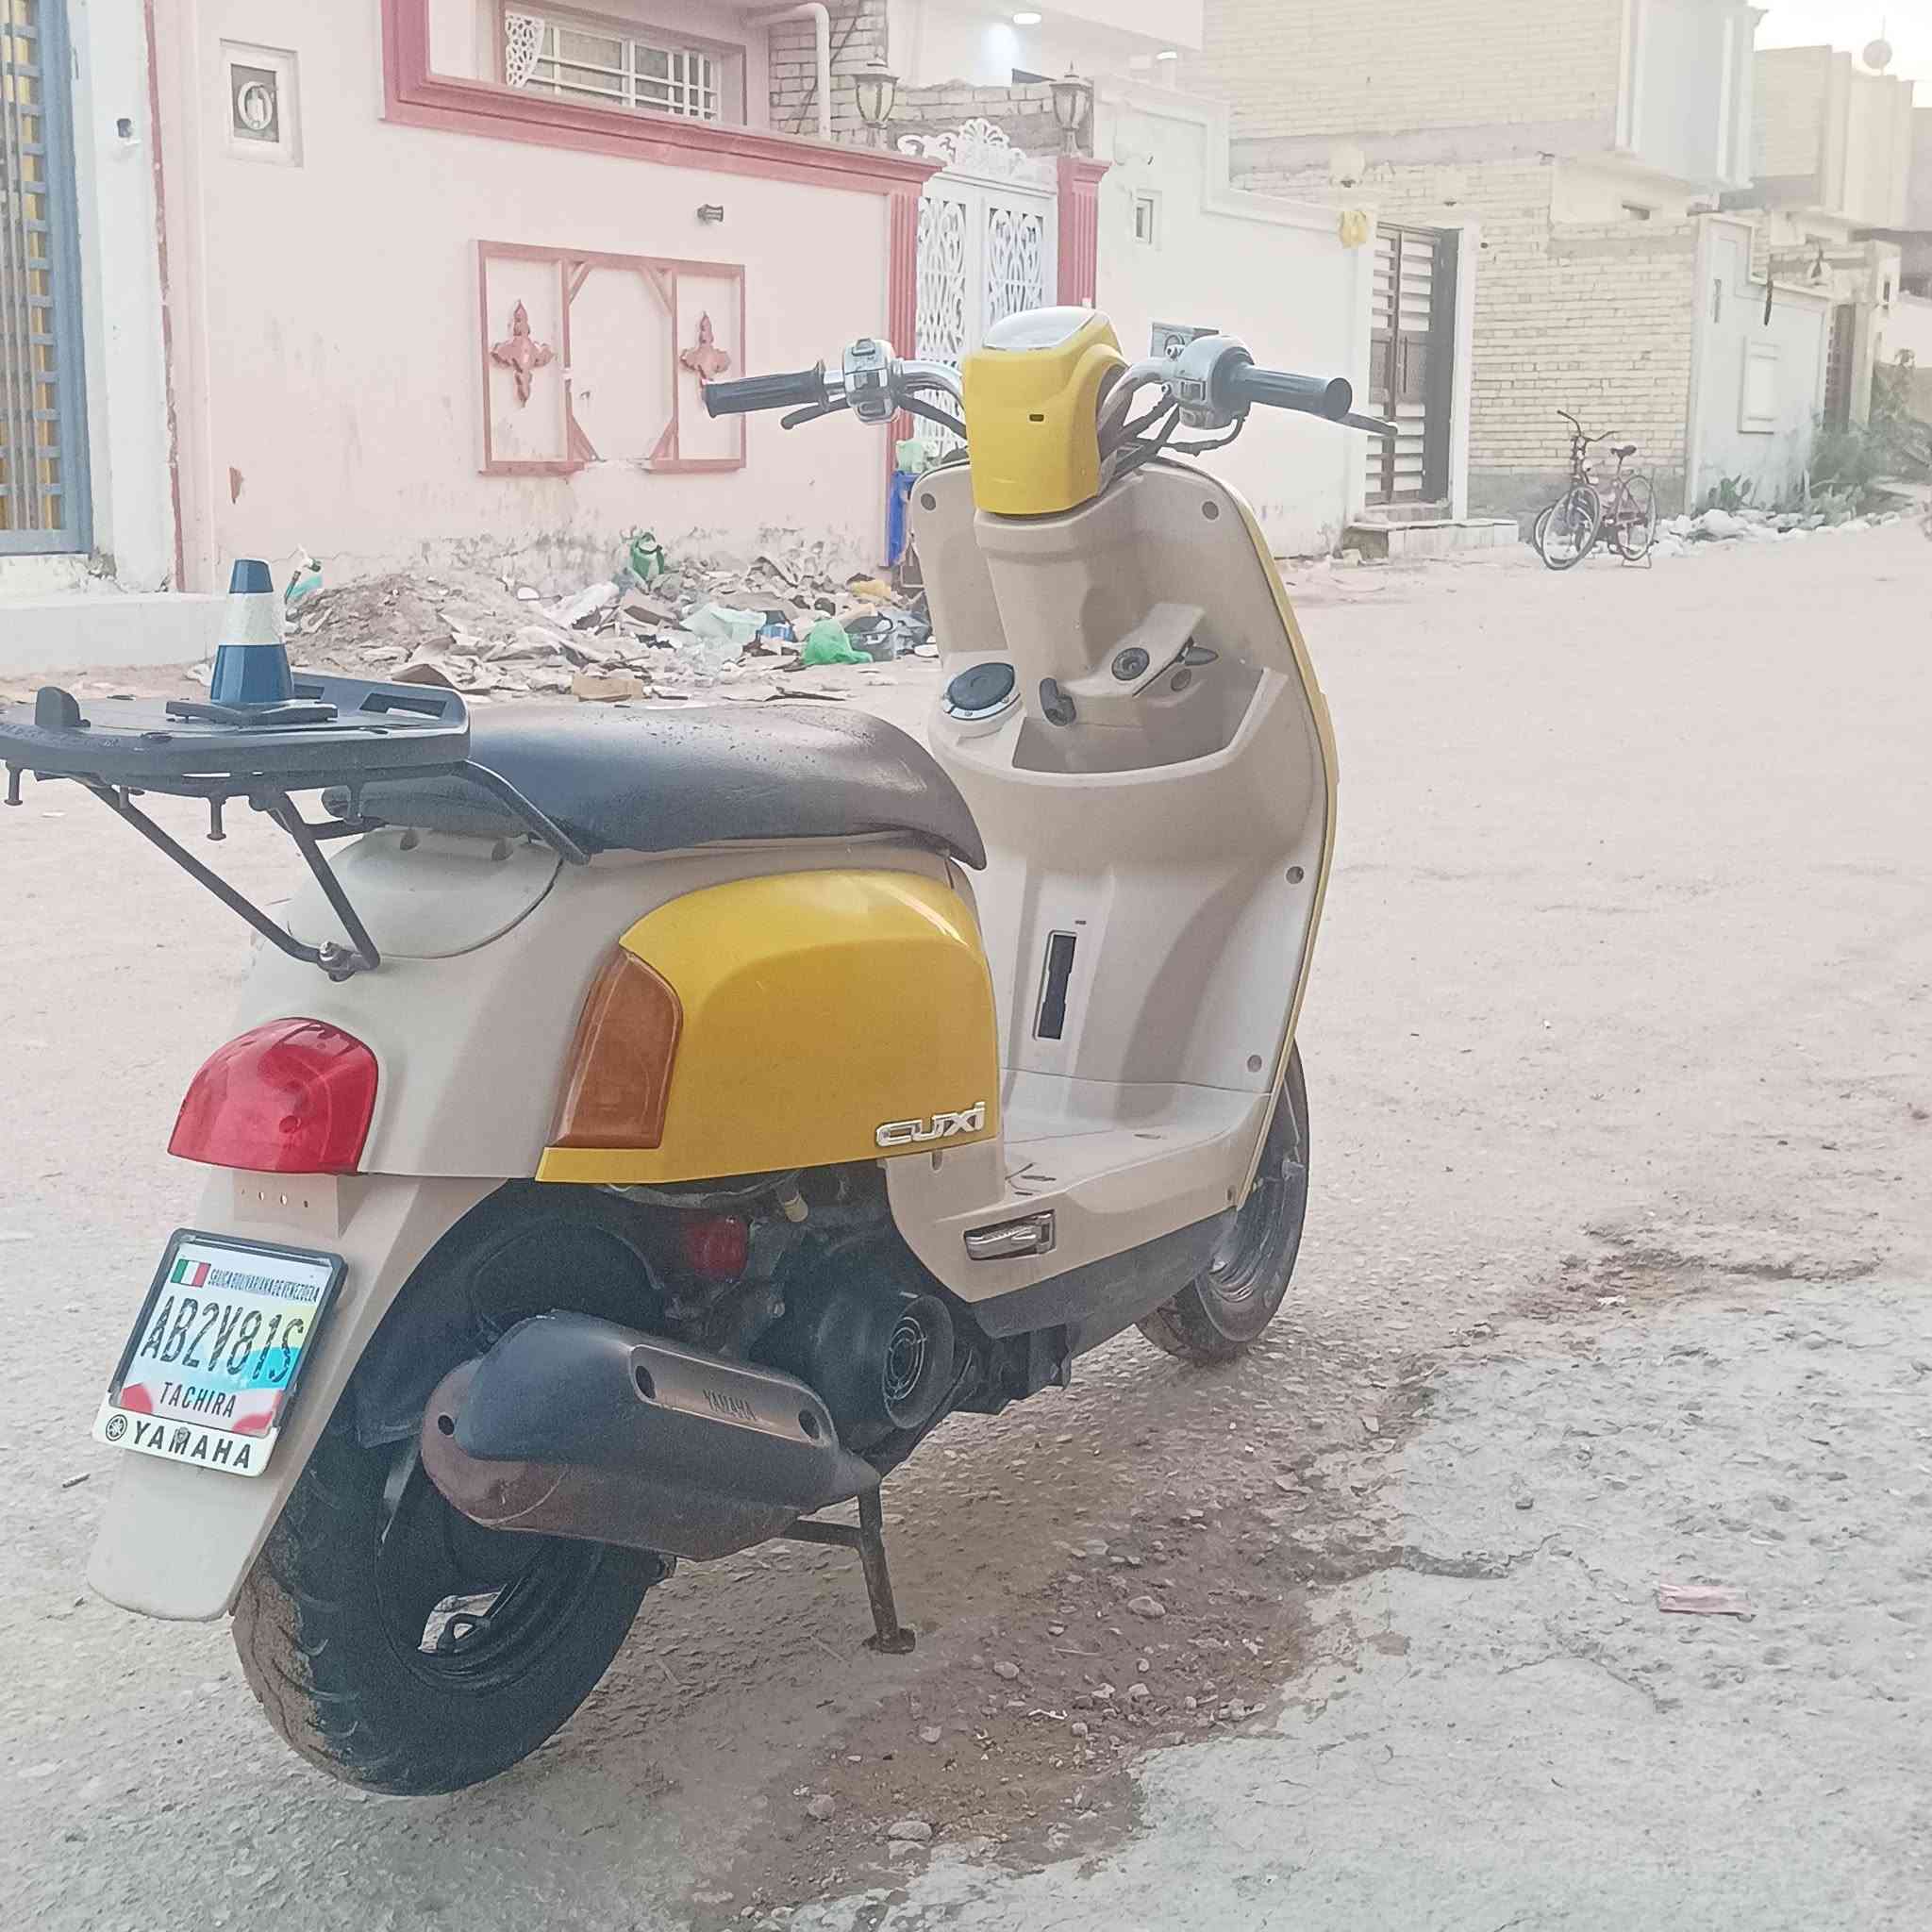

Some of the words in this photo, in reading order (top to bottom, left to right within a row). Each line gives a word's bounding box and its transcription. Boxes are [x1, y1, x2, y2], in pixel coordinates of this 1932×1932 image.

[141, 1295, 304, 1383] AB2V81S
[159, 1381, 237, 1418] TACHIRA
[134, 1419, 252, 1469] YAMAHA
